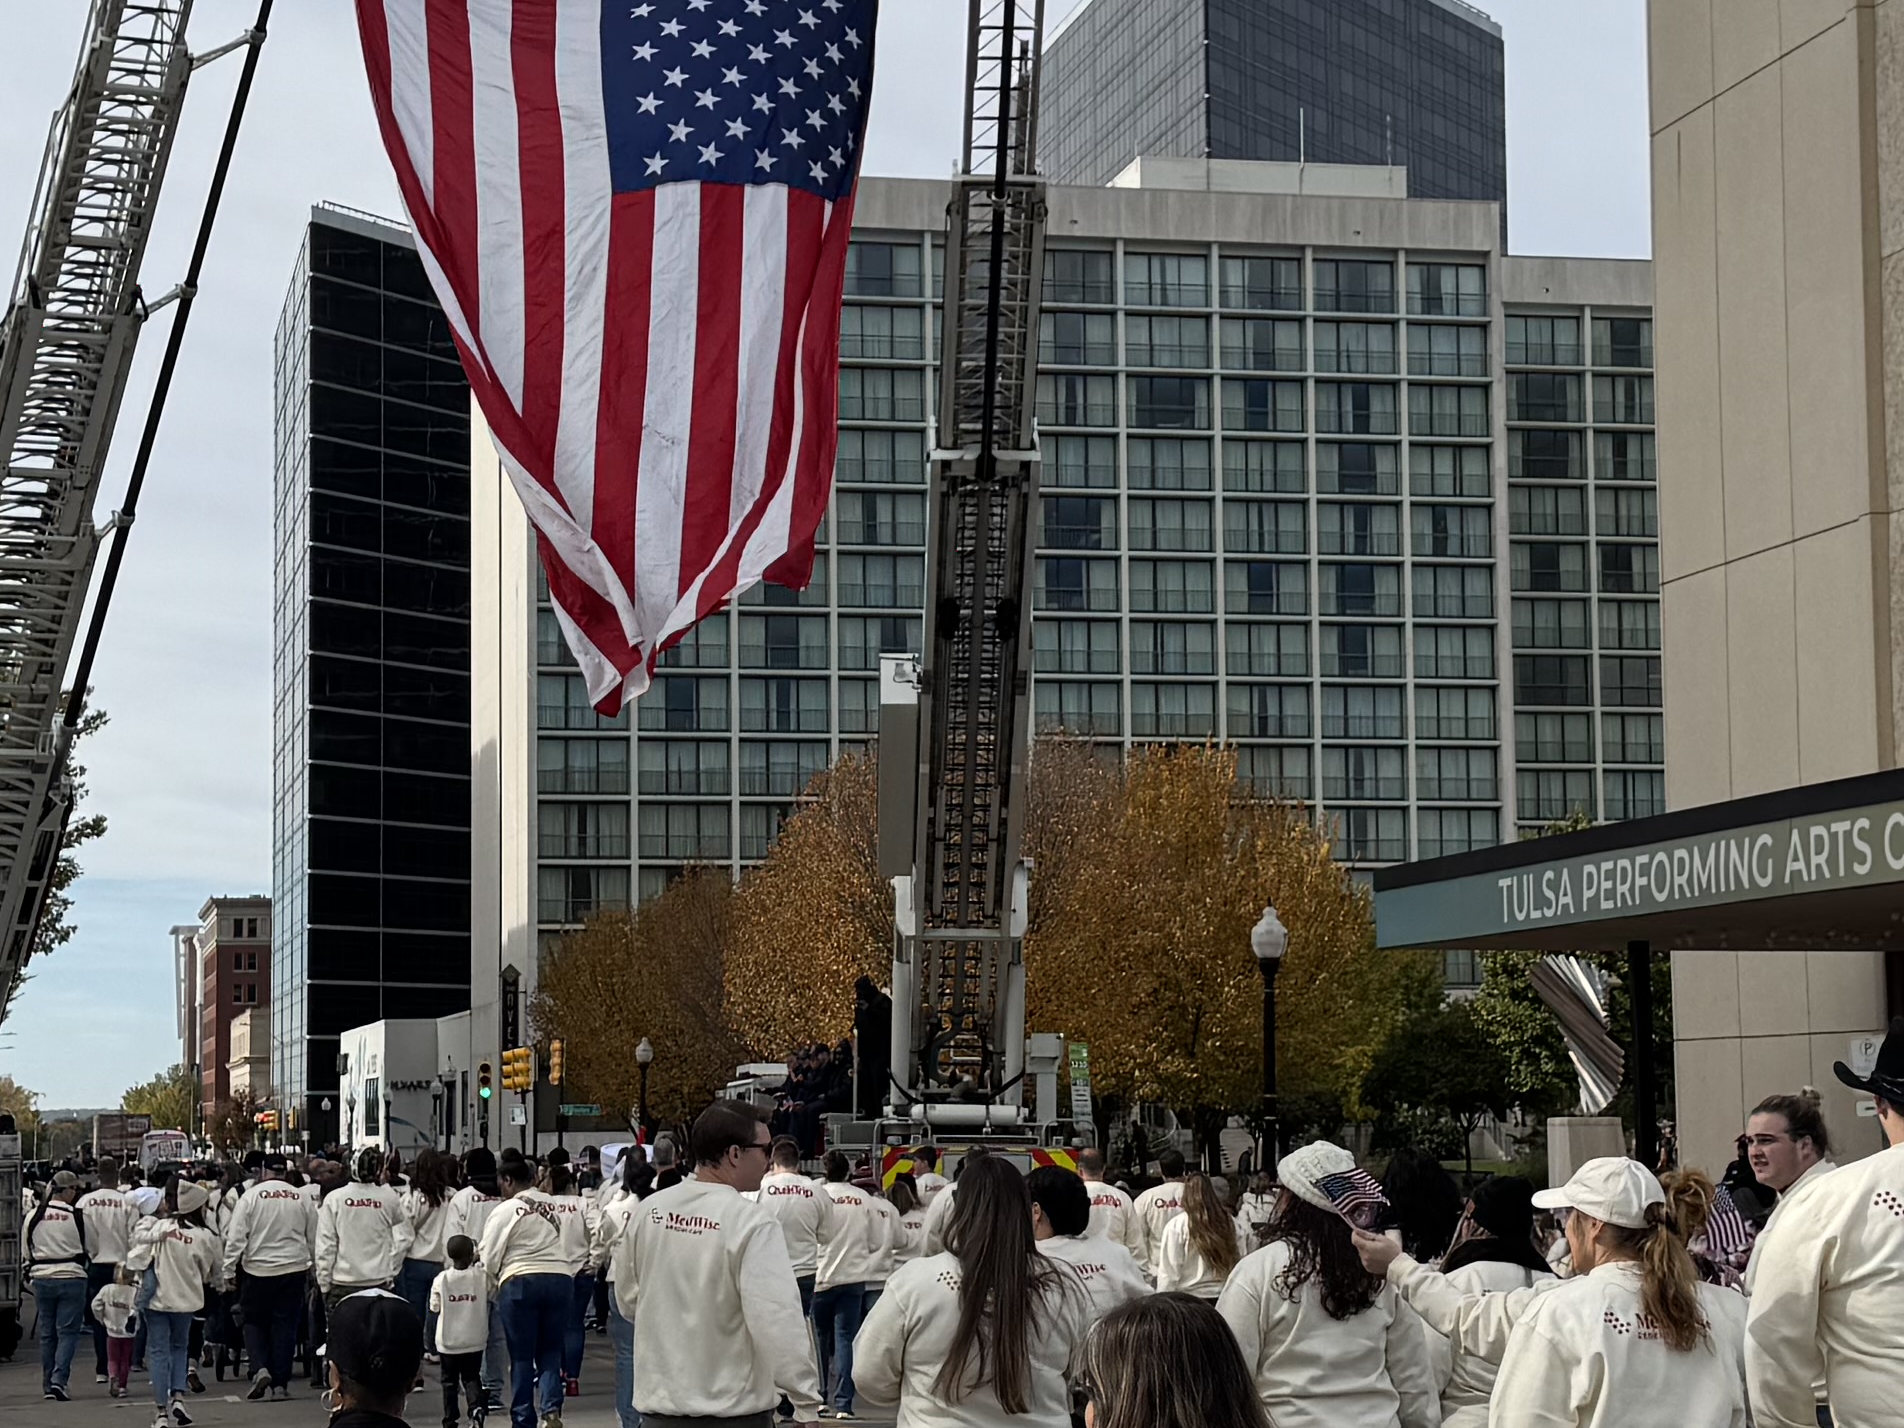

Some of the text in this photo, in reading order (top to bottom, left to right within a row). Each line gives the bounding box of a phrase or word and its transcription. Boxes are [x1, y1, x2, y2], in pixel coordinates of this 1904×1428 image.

[1498, 866, 1574, 923] TULSA
[1582, 833, 1773, 913] PERFORMING
[1784, 818, 1872, 884] ARTS
